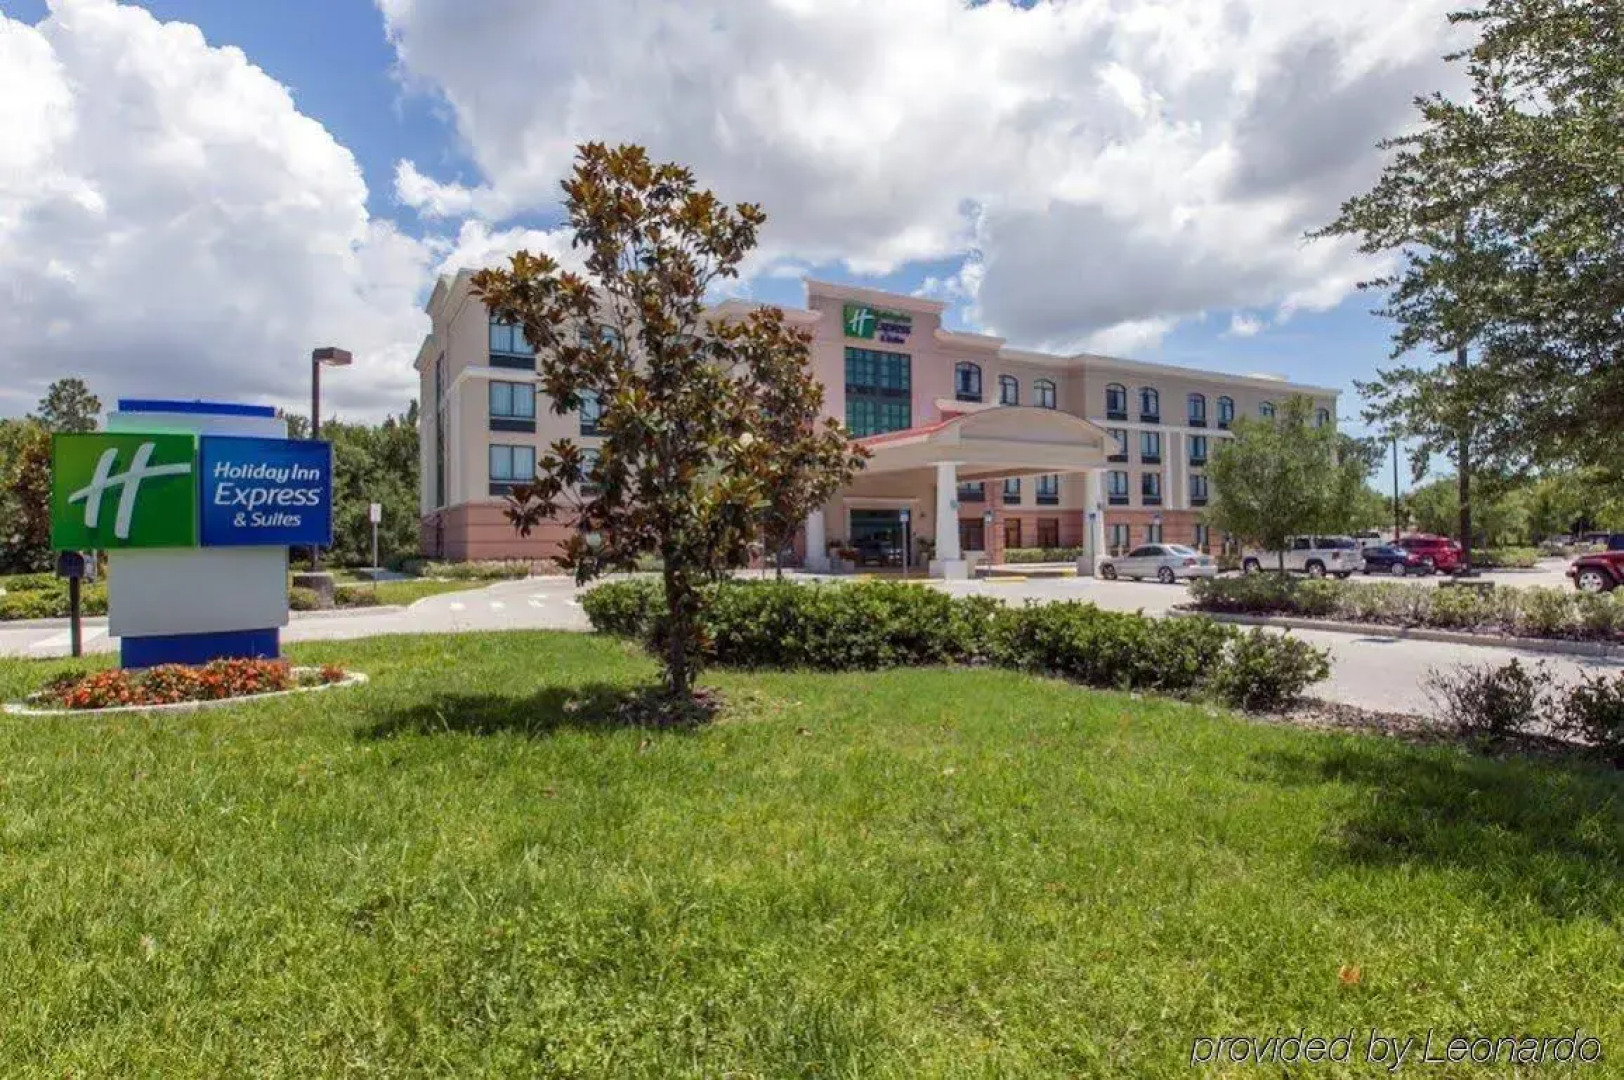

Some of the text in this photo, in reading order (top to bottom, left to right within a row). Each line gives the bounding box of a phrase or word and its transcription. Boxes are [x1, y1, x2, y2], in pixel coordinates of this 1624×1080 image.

[213, 461, 320, 484] Holiday Inn
[213, 482, 321, 511] Express
[233, 511, 302, 527] & Suites
